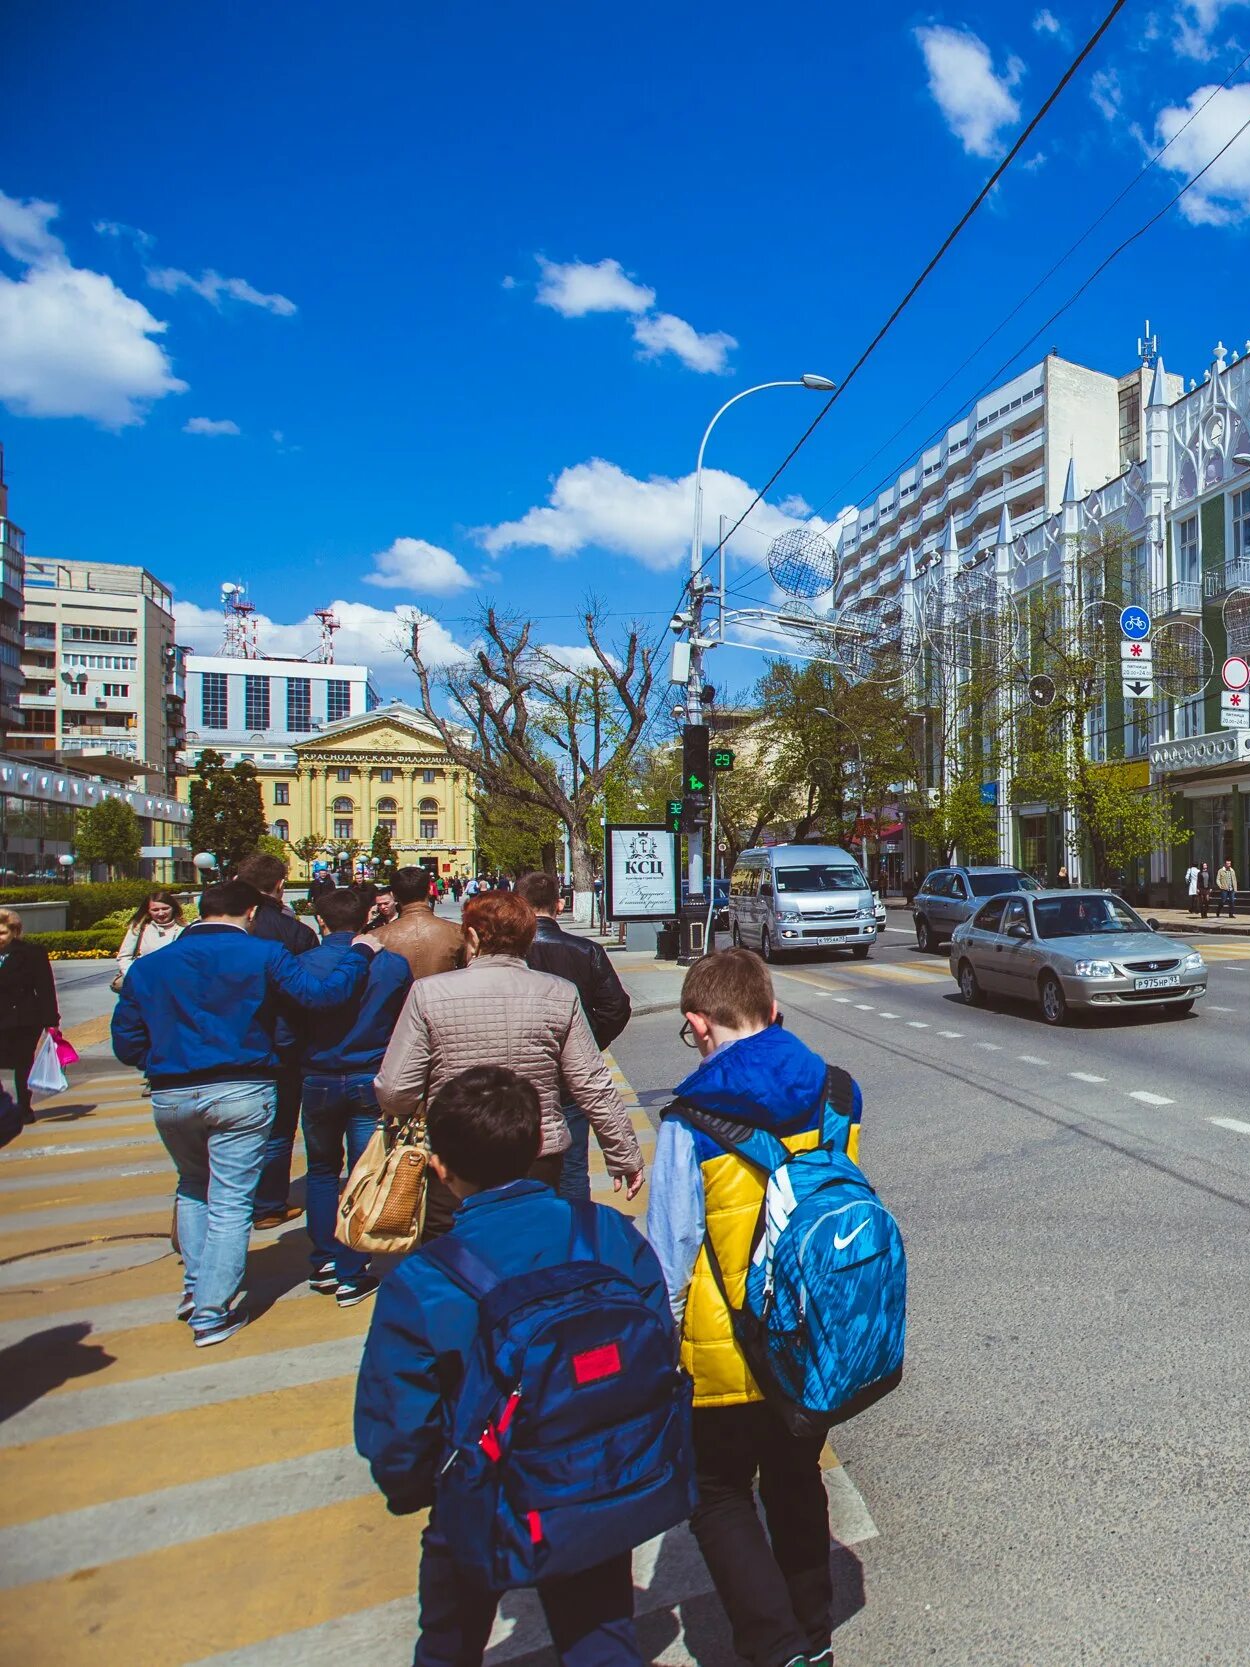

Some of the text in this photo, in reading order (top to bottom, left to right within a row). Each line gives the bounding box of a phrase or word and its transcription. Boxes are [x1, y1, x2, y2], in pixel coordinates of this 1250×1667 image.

[303, 753, 456, 764] КРАСНОДАРСКАЯ ФИЛАРМОНИ
[715, 754, 730, 766] 29
[625, 860, 664, 877] КСЦ
